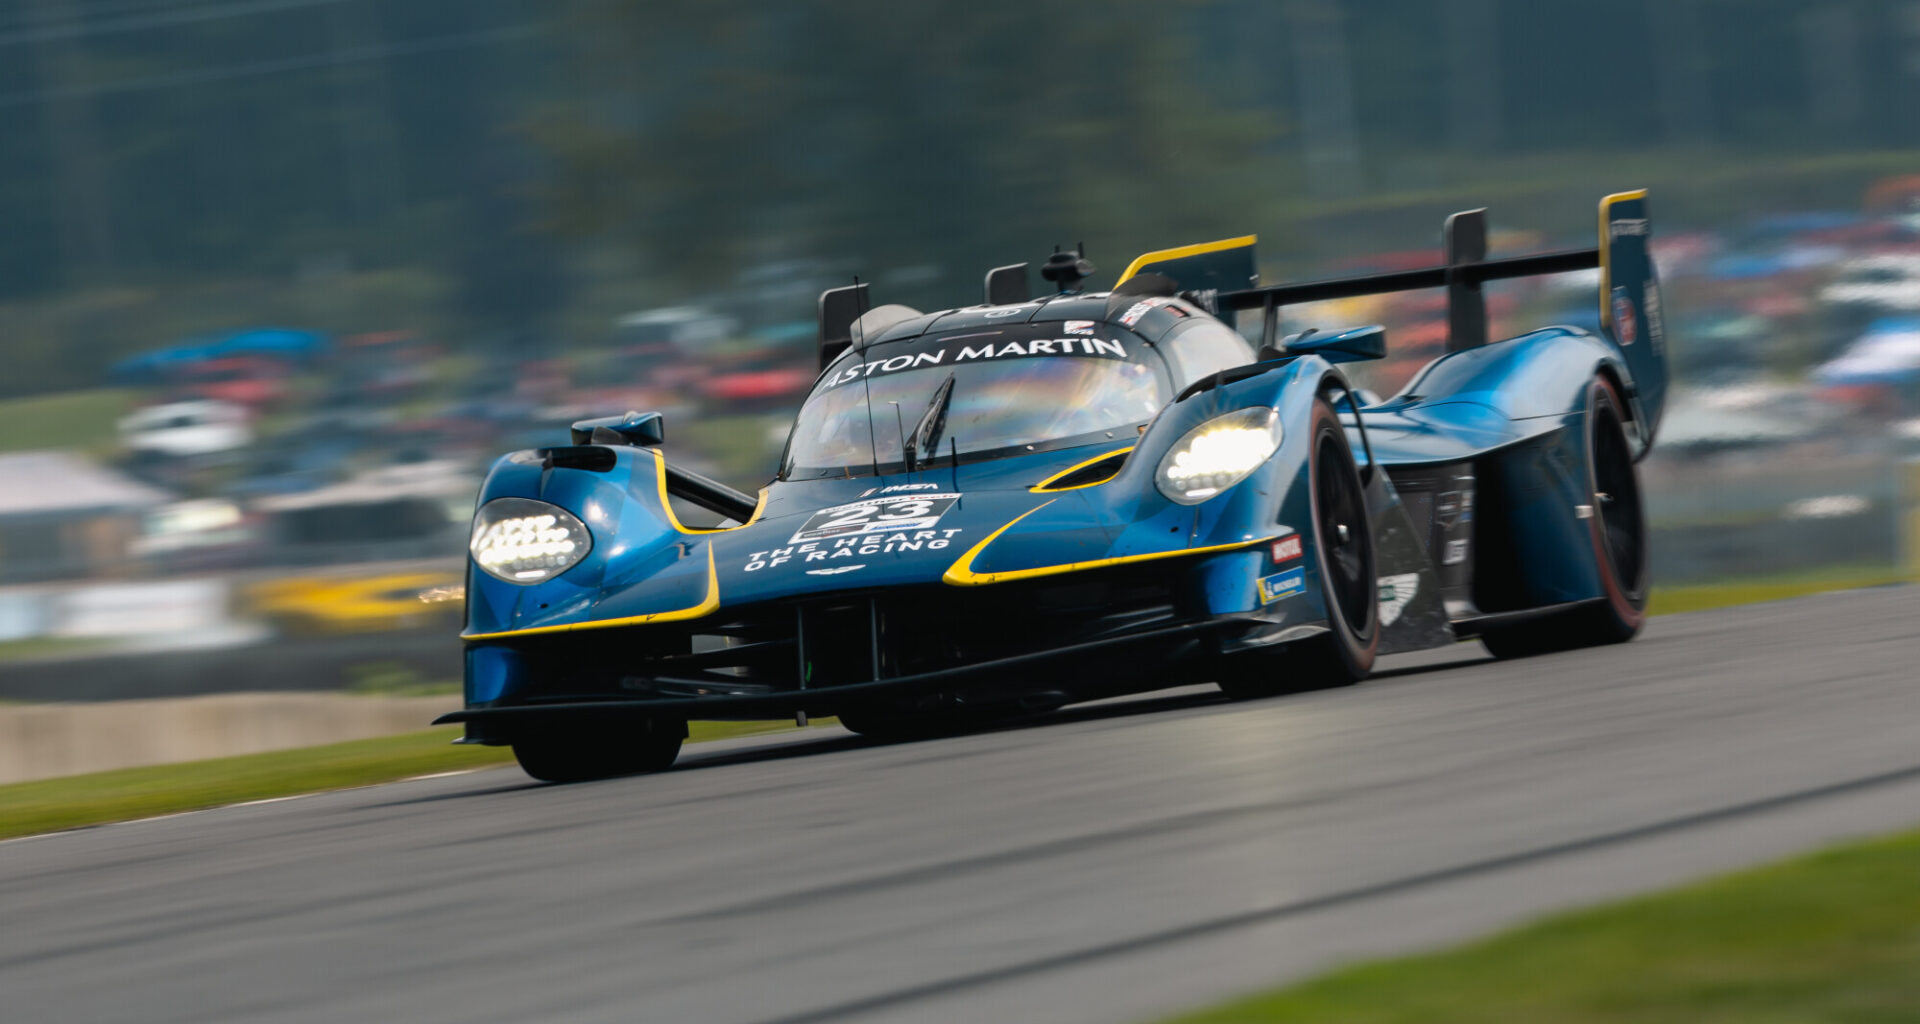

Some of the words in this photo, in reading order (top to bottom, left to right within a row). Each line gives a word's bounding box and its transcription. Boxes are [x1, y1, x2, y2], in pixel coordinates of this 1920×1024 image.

[822, 349, 945, 391] ASTON
[955, 337, 1128, 362] MARTIN
[880, 483, 939, 494] IMSA
[816, 499, 935, 530] 23
[743, 555, 792, 572] OF
[805, 538, 951, 563] RACING
[749, 543, 820, 562] THE
[834, 528, 963, 548] HEART
